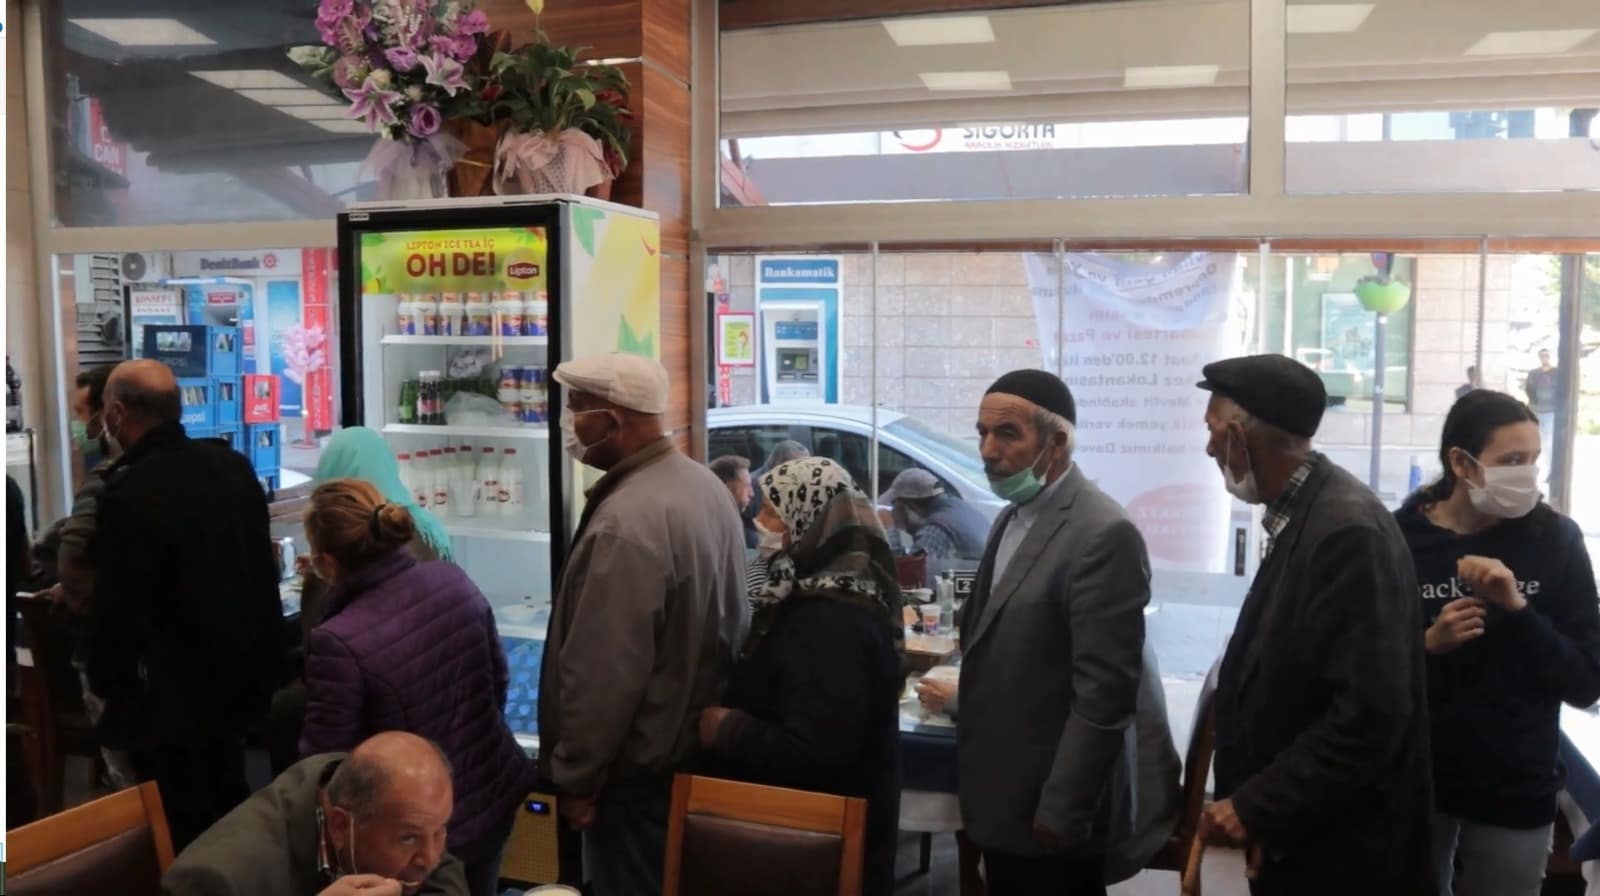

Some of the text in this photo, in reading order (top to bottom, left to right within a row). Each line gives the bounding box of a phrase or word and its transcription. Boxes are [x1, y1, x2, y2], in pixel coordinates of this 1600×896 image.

[406, 241, 441, 250] LIPTON
[444, 240, 460, 249] ICE
[464, 239, 481, 248] TEA
[406, 252, 495, 277] OH DE!
[509, 265, 538, 277] Lipton
[764, 267, 835, 278] Bankamatik
